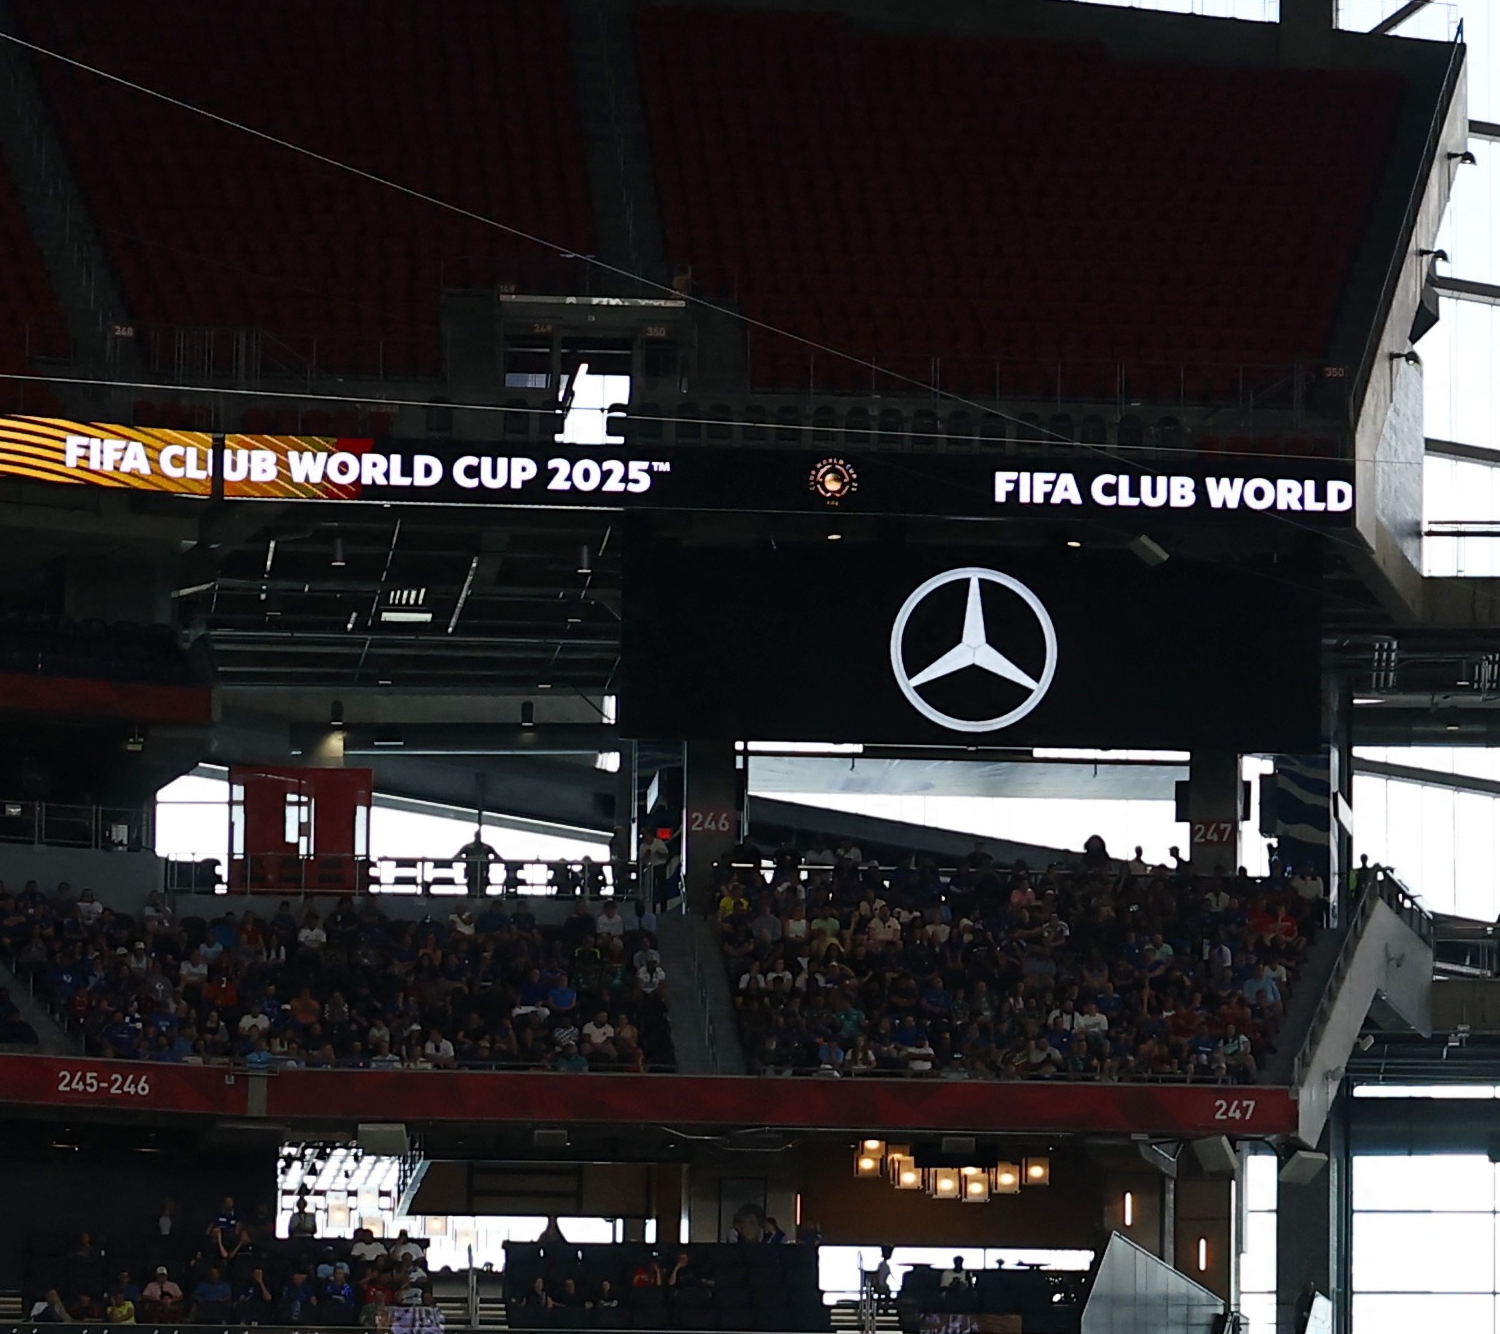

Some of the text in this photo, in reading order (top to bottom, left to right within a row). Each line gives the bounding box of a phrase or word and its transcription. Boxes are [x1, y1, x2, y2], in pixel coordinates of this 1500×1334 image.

[65, 435, 151, 476] FIFA
[159, 444, 278, 483] CLUB
[287, 450, 443, 489] WORLD
[452, 455, 538, 492] CUP
[995, 471, 1353, 513] FIFA CLUB WORLD
[690, 810, 730, 833] 246
[1193, 823, 1232, 845] 247
[57, 1070, 150, 1098] 245-246
[1214, 1098, 1256, 1121] 247
